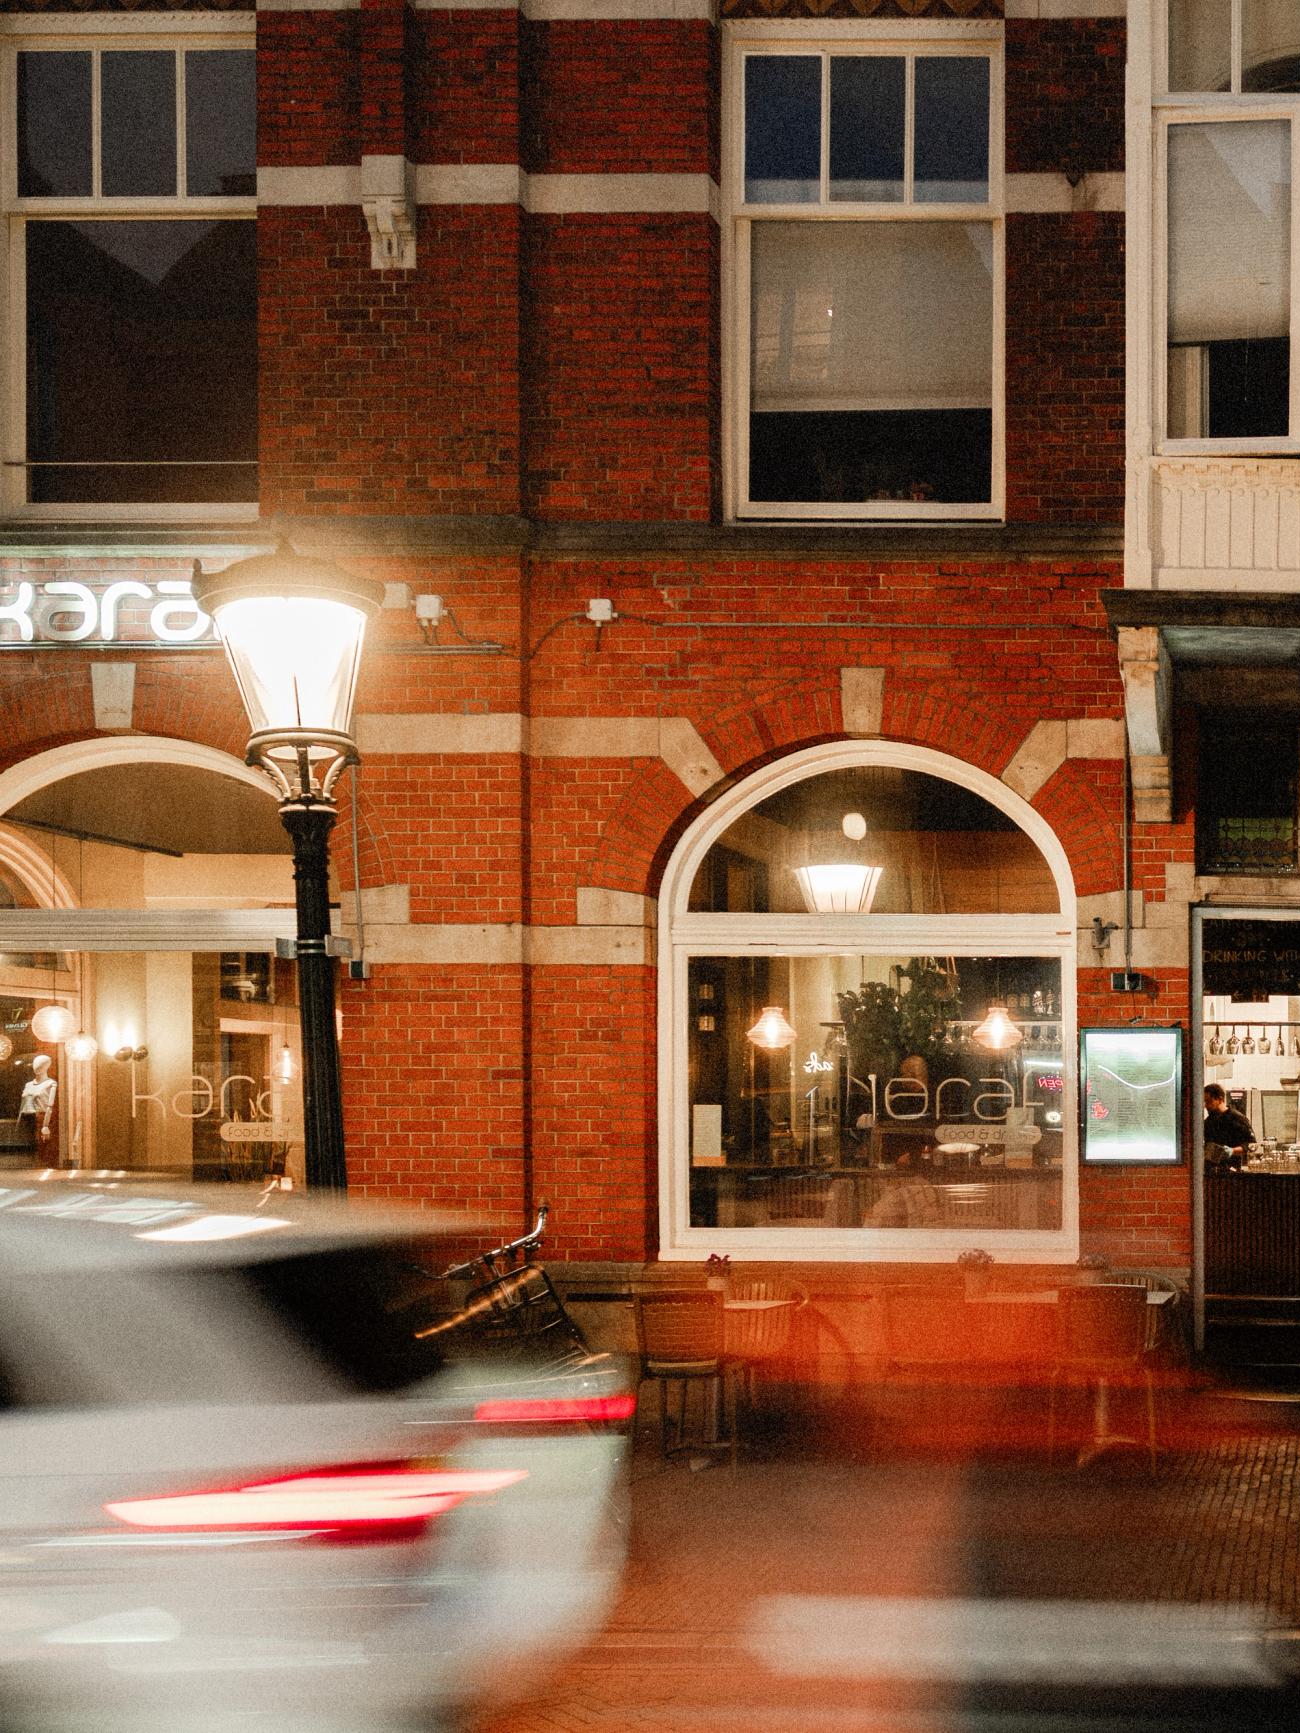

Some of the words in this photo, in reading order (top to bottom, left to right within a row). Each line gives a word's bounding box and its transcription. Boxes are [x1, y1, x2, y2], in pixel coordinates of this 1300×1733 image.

[0, 581, 212, 641] kara
[1203, 950, 1267, 963] DRINKING
[132, 1061, 298, 1119] kara
[228, 1126, 260, 1139] food
[942, 1127, 975, 1141] food
[979, 1128, 991, 1140] &
